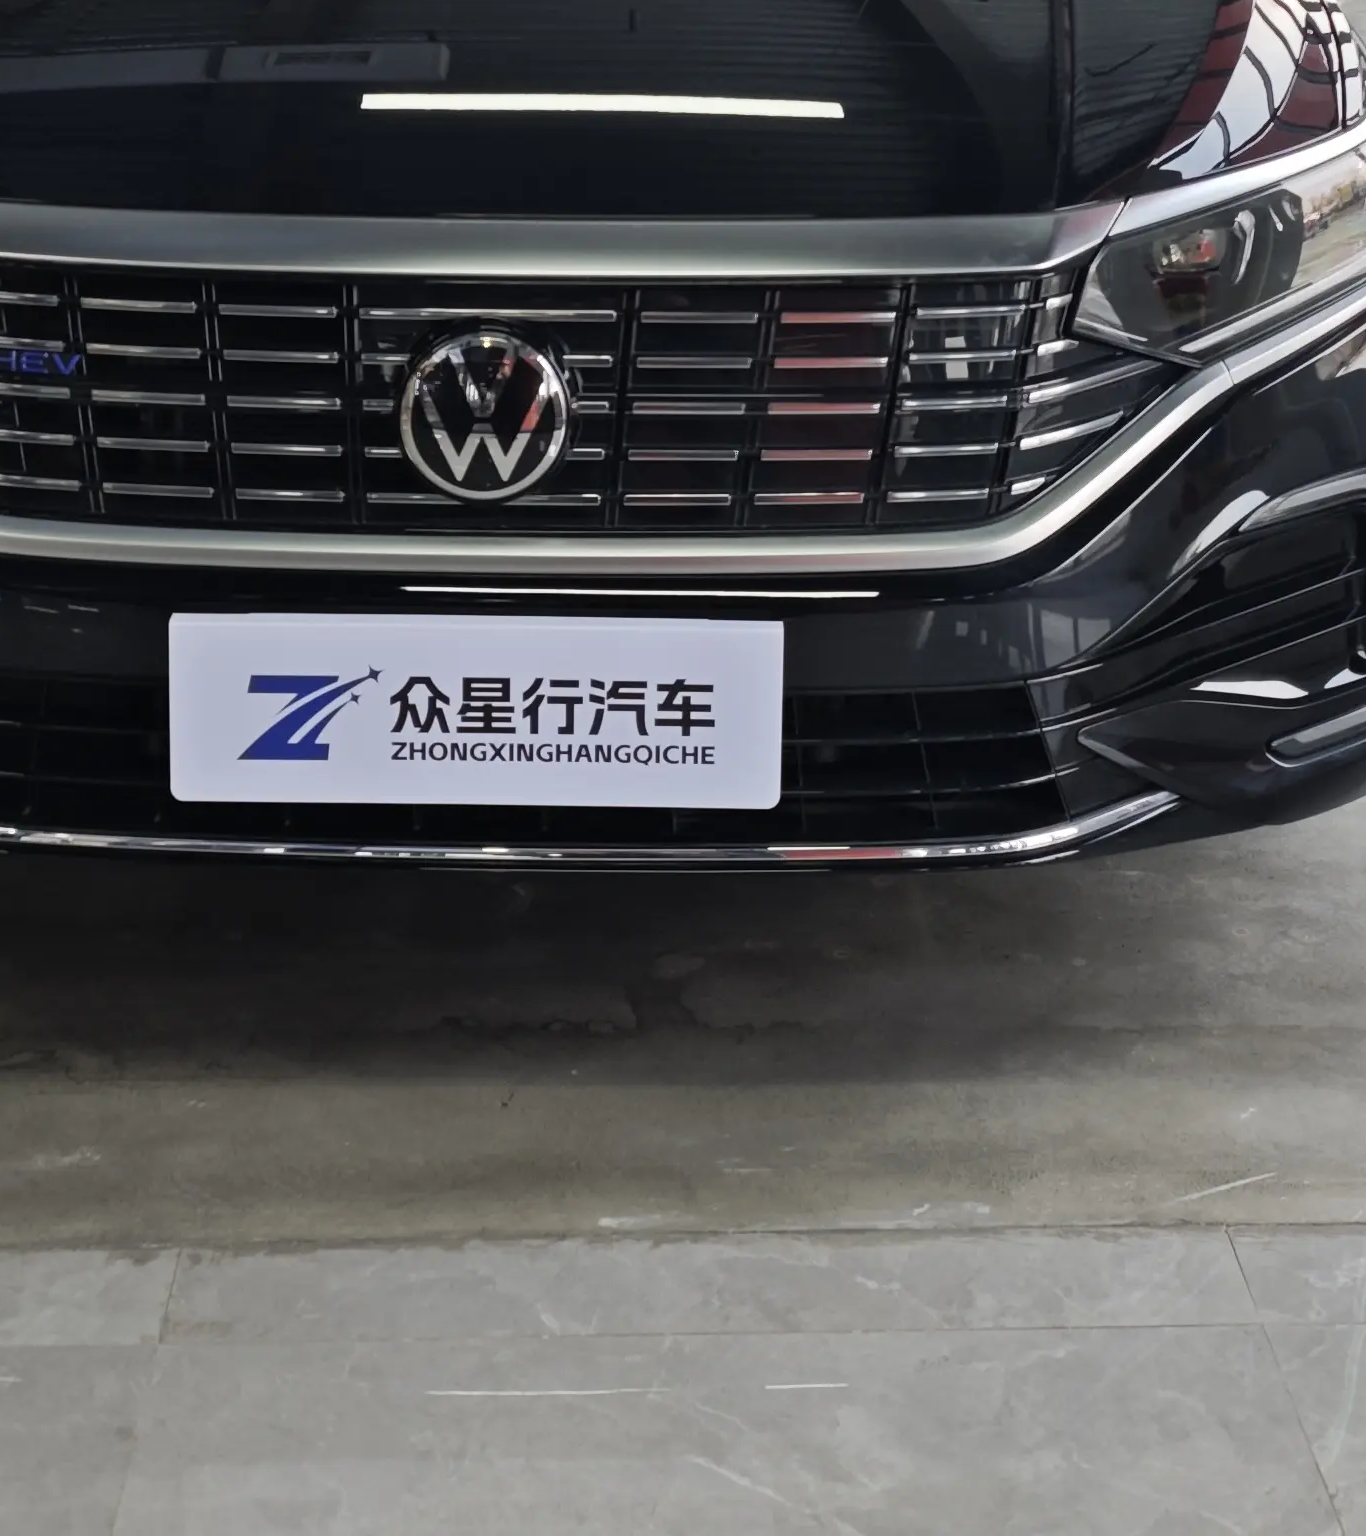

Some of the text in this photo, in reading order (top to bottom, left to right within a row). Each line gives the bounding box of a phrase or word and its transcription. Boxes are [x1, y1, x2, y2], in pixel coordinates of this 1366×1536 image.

[389, 675, 716, 737] 众星行汽车
[390, 740, 716, 766] ZHONGXINGHANGQICHE
